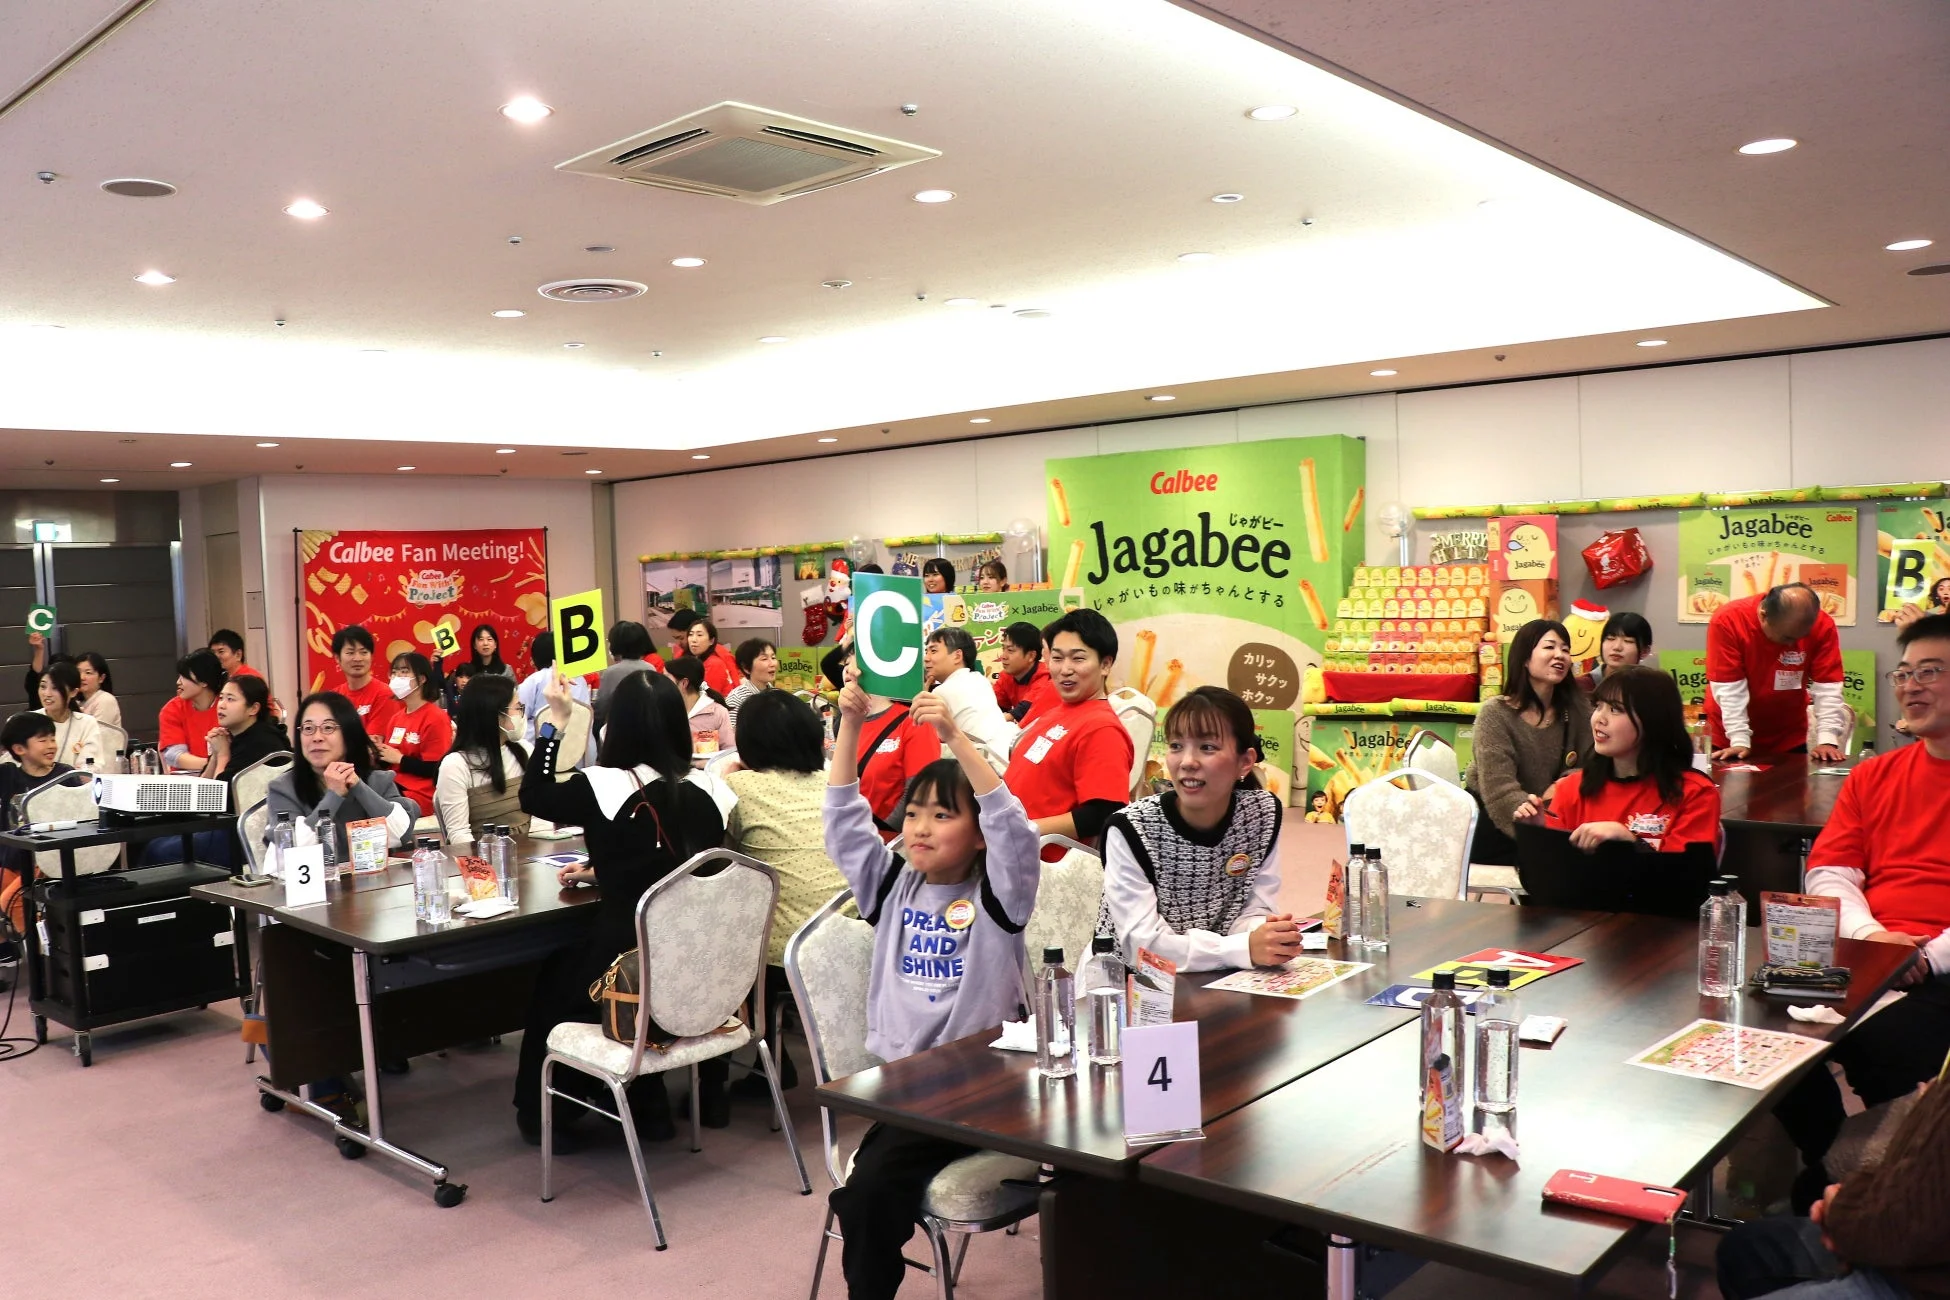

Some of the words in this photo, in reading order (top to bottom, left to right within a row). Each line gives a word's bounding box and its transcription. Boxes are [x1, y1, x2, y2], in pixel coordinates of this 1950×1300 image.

[1151, 470, 1218, 494] Calbee
[1229, 513, 1284, 530] じゃがビー
[1719, 512, 1813, 540] Jagabee
[1826, 513, 1853, 522] Calbee
[329, 541, 395, 563] Calbee
[402, 543, 437, 562] Fan
[442, 540, 525, 564] Meeting!
[1087, 511, 1291, 585] Jagabee
[1515, 560, 1546, 570] Jagabee
[1893, 550, 1925, 597] B
[409, 586, 454, 601] Project
[1093, 581, 1285, 611] じゃがいもの味がちゃんとする
[28, 608, 54, 631] C
[974, 611, 1003, 620] Project
[1022, 603, 1059, 615] Jagabee
[435, 628, 455, 650] B
[560, 604, 599, 665] B
[856, 589, 919, 677] C
[778, 659, 813, 673] Jagabee
[1243, 653, 1275, 668] カリッ
[1256, 673, 1288, 689] サクッ
[1242, 689, 1275, 705] ホクッ
[1425, 702, 1457, 713] Jagabee
[1334, 704, 1365, 714] Jagabee
[298, 865, 311, 884] 3
[910, 934, 957, 955] AND
[902, 956, 963, 978] SHINE
[1147, 1056, 1173, 1092] 4
